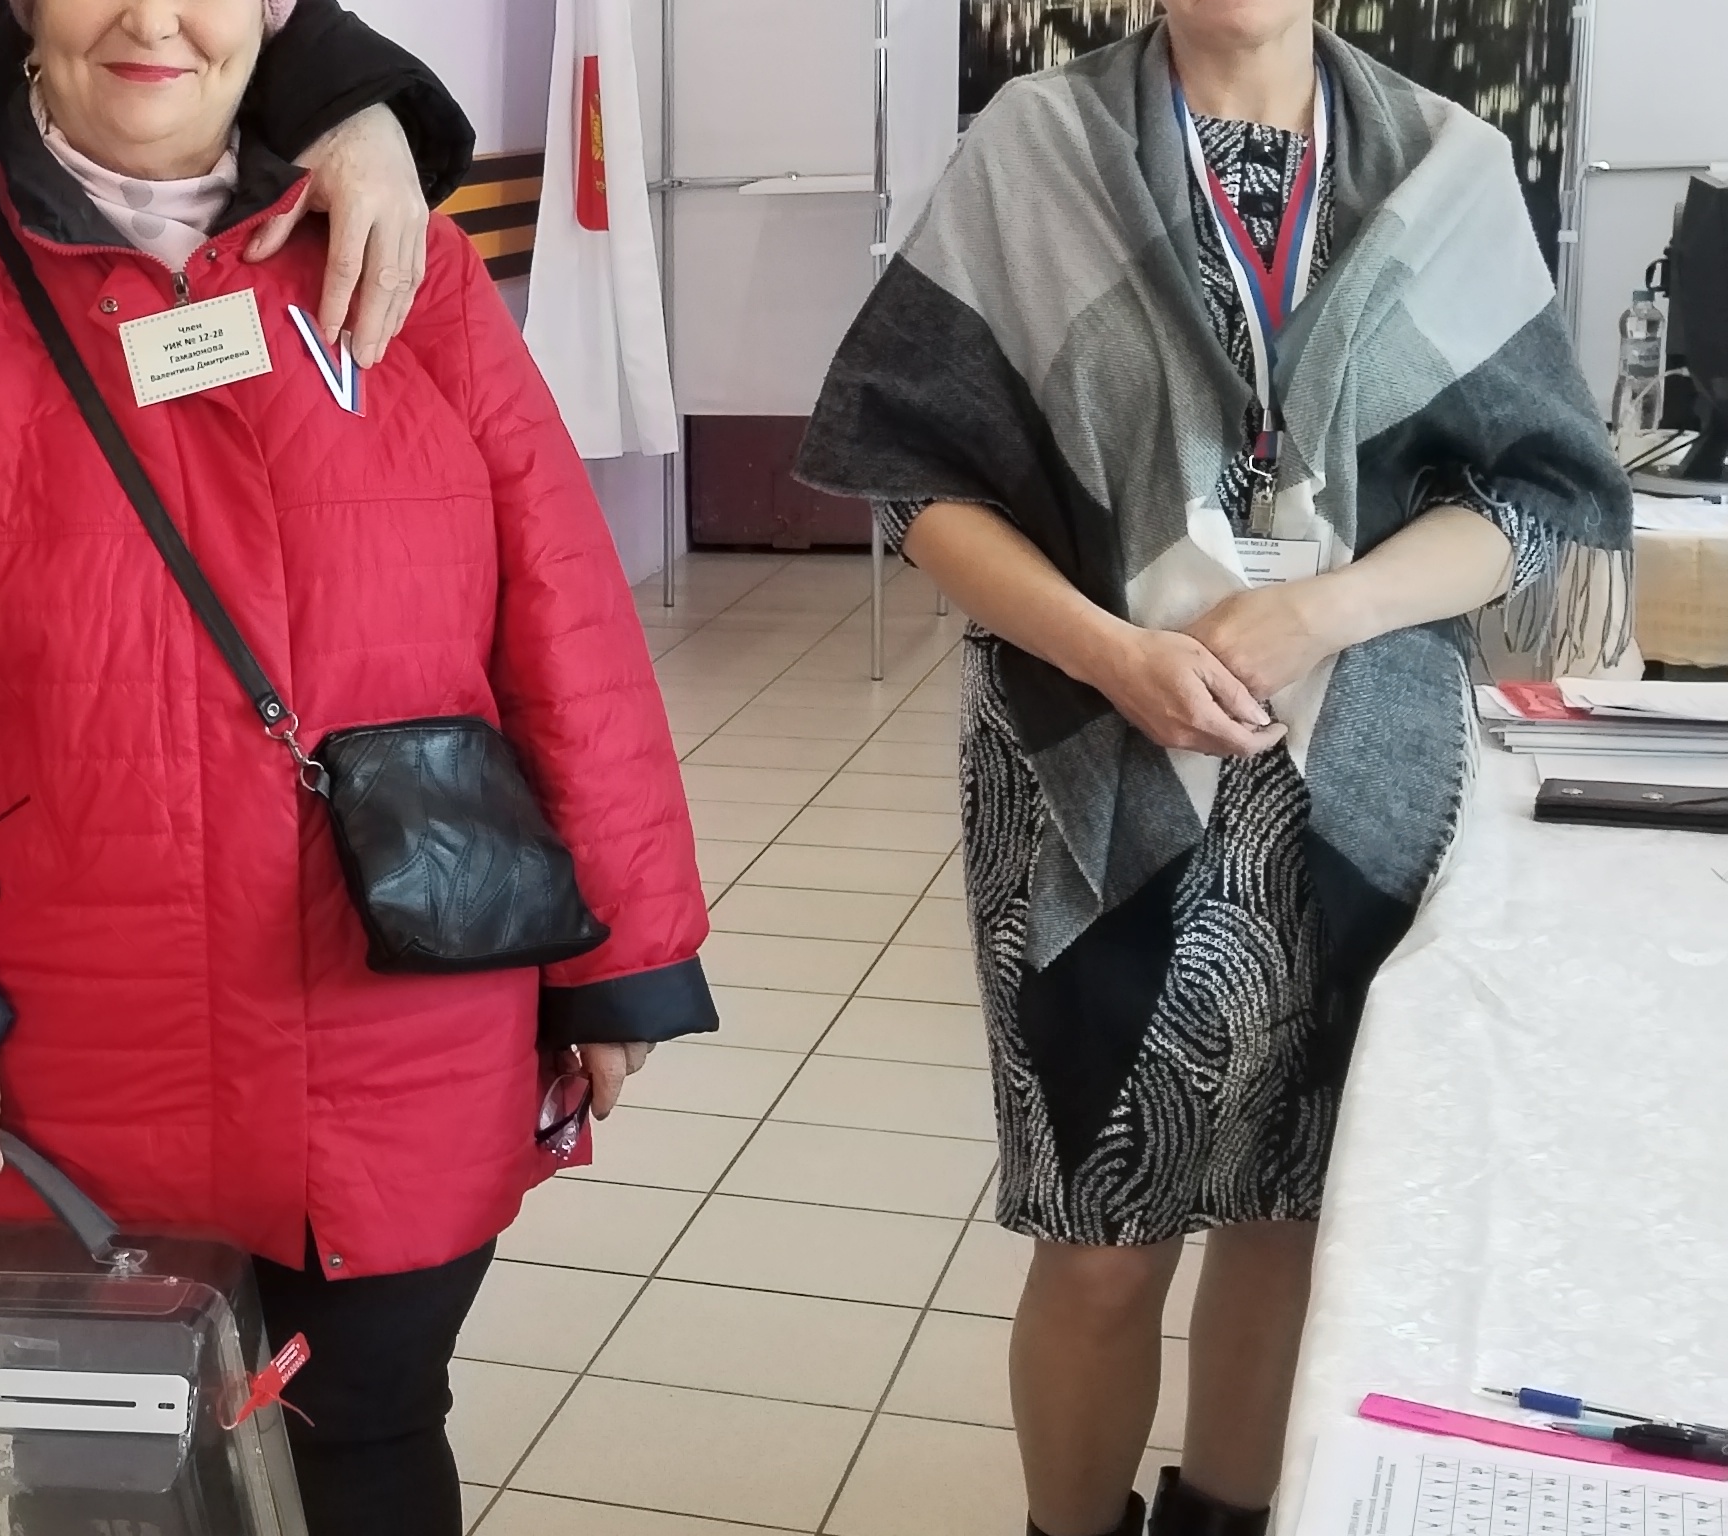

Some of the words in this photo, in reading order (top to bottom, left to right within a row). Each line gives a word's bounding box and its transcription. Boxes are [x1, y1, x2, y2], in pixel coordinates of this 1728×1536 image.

[178, 323, 202, 334] Член
[163, 339, 183, 353] УИК
[184, 337, 197, 346] №
[198, 329, 224, 342] 12-28
[170, 344, 224, 365] Гамаюнова
[150, 365, 195, 383] Валентина
[197, 349, 250, 371] Дмитриевна
